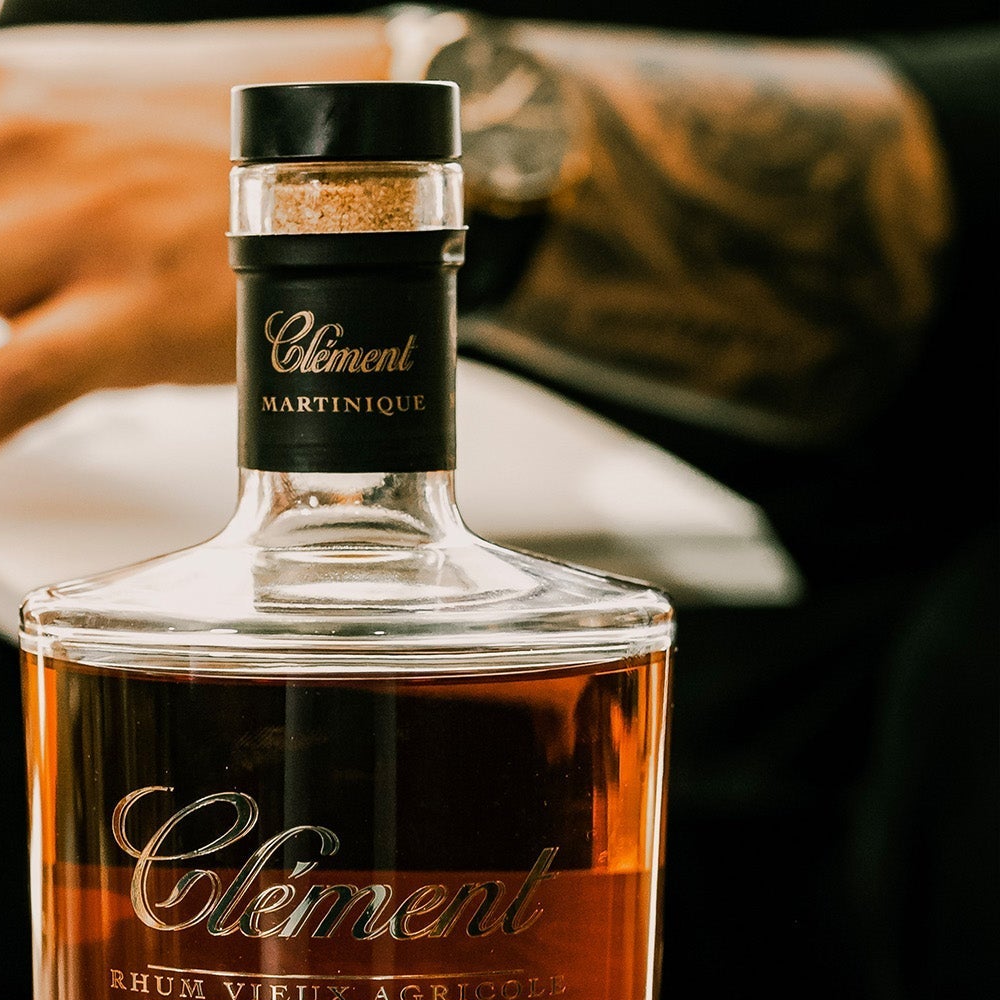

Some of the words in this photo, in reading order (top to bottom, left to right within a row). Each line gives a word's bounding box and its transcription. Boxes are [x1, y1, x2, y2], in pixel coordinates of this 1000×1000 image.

[264, 310, 418, 374] Clément
[261, 394, 426, 416] MARTINIQUE
[111, 785, 561, 941] Clément
[110, 968, 206, 1000] RHUM
